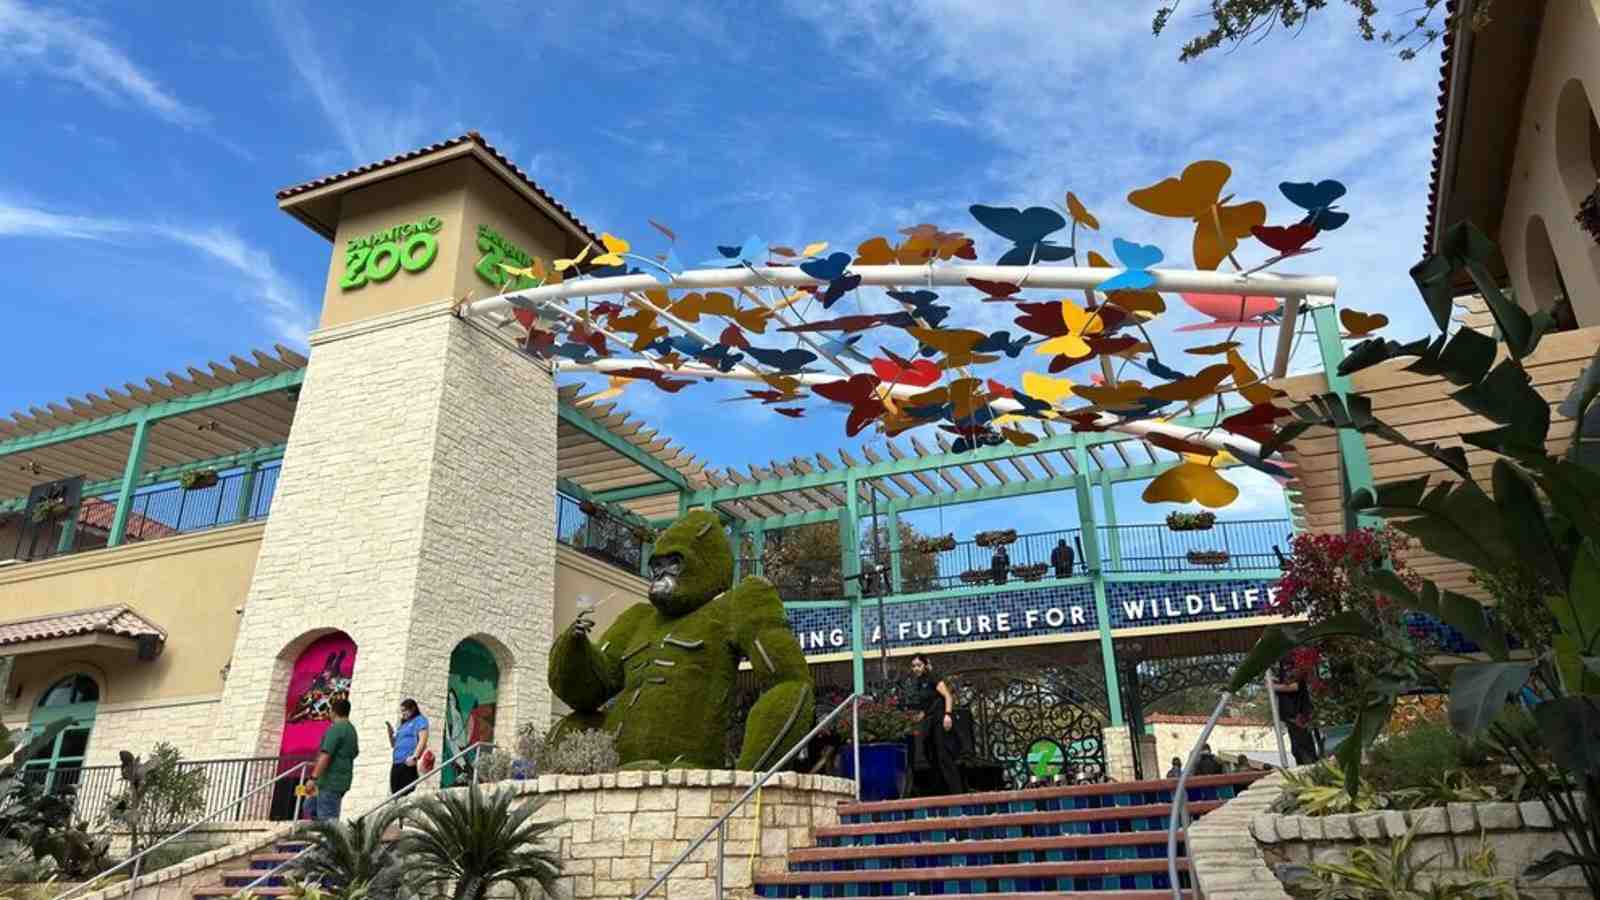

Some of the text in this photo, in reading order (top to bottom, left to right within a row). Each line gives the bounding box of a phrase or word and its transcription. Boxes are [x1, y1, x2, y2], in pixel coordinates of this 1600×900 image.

[339, 232, 438, 289] ZOO
[899, 612, 1010, 640] FUTURE
[1026, 606, 1086, 628] FOR
[1123, 586, 1283, 620] WILDLIFE
